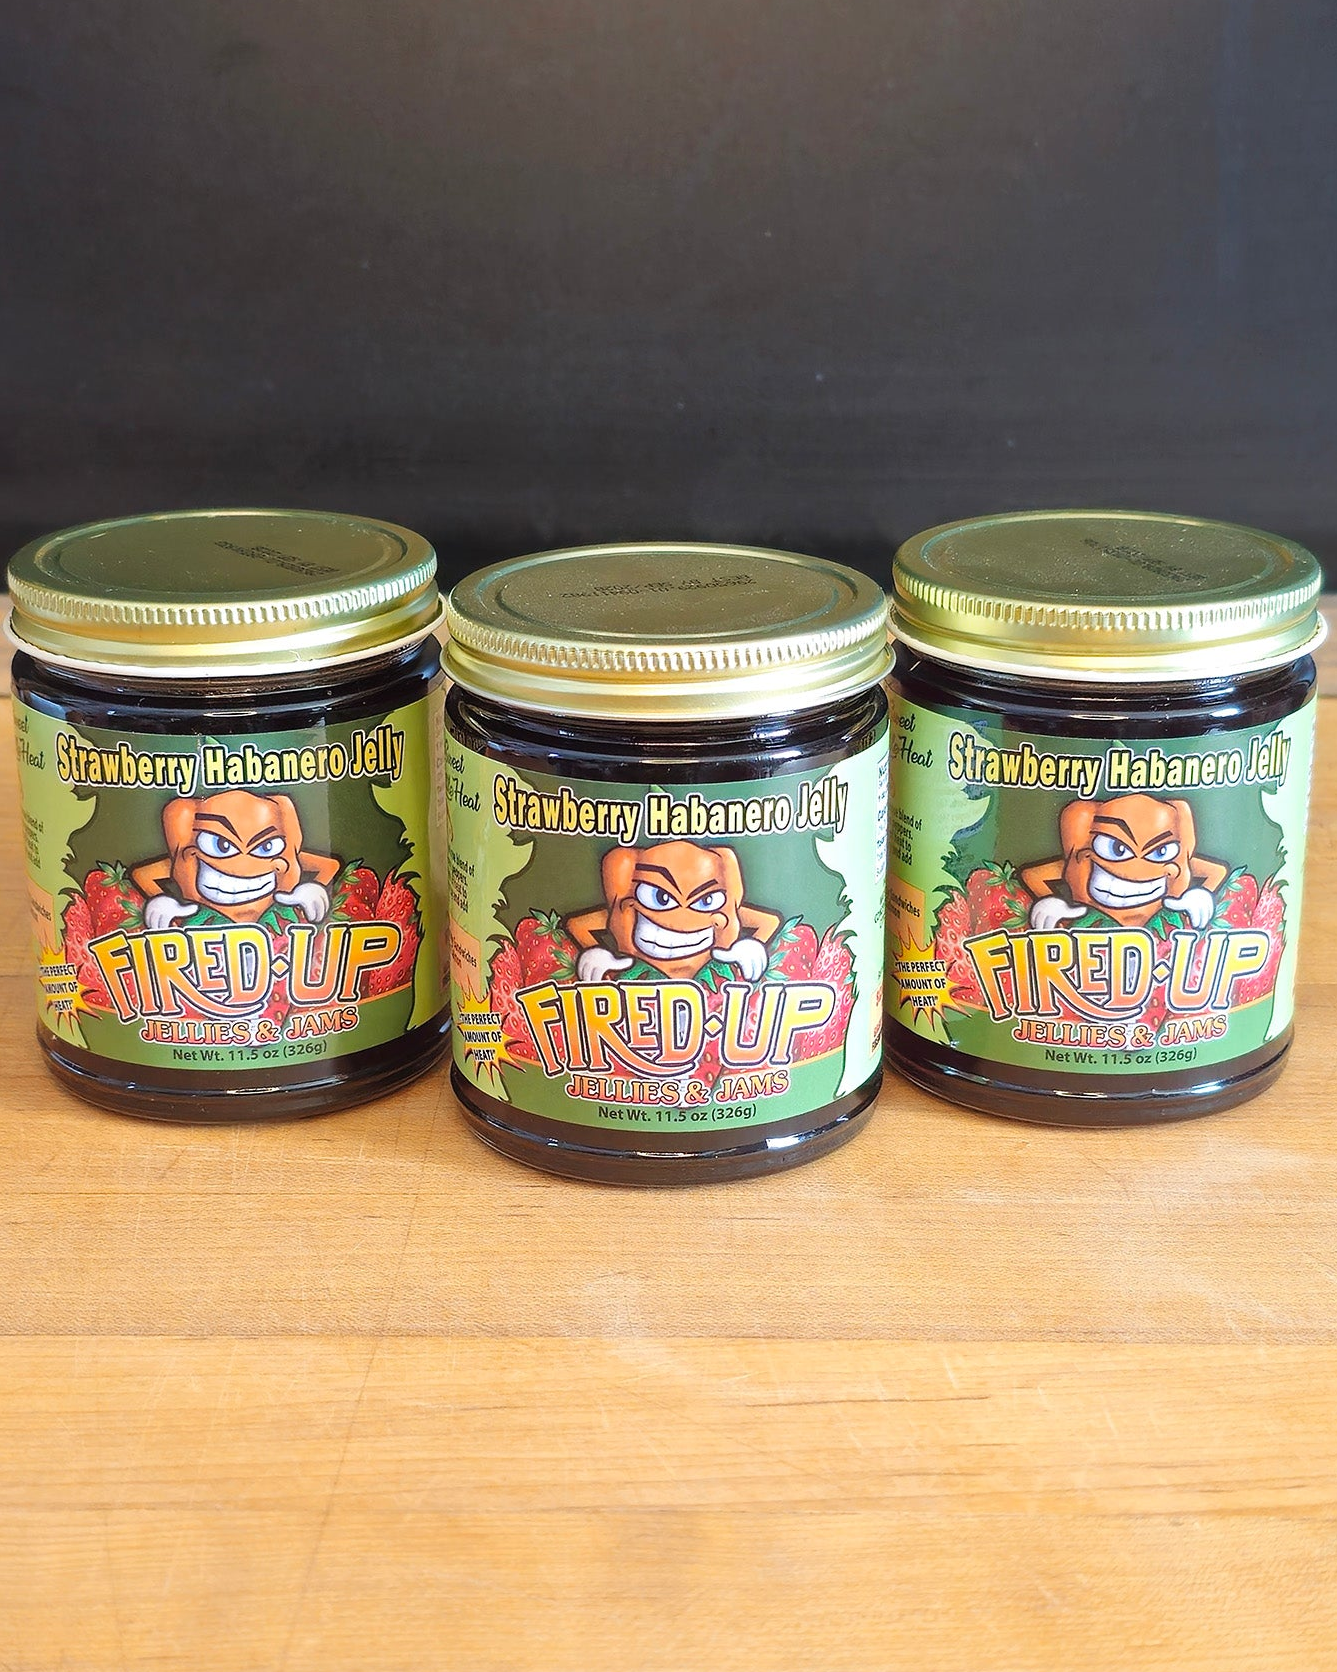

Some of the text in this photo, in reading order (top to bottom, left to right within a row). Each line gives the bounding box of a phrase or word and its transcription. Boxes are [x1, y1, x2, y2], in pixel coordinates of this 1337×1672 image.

[56, 723, 405, 797] Strawberry Habanero Jelly
[899, 735, 934, 768] Heat
[949, 729, 1292, 797] Strawberry Habanero Jelly
[452, 776, 481, 812] Heat
[493, 773, 641, 845] Strawberry
[647, 793, 793, 836] Habanero
[796, 774, 849, 834] Jelly
[51, 964, 77, 976] PERFECT
[911, 960, 946, 972] PERFECT
[68, 982, 79, 993] OF
[900, 978, 946, 990] AMOUNT OF
[140, 1006, 359, 1046] JELLIES & JAMS
[471, 1012, 501, 1025] PERFECT
[464, 1030, 502, 1043] AMOUNT OF
[1013, 1014, 1228, 1048] JELLIES & JAMS
[172, 1039, 328, 1062] Net Wt. 11.5 oz (326g)
[1045, 1047, 1198, 1065] Net Wt. 11.5 oz (326g)
[565, 1069, 789, 1105] JELLIES & JAMS
[598, 1103, 757, 1123] Net Wt. 11.5 oz (326g)
